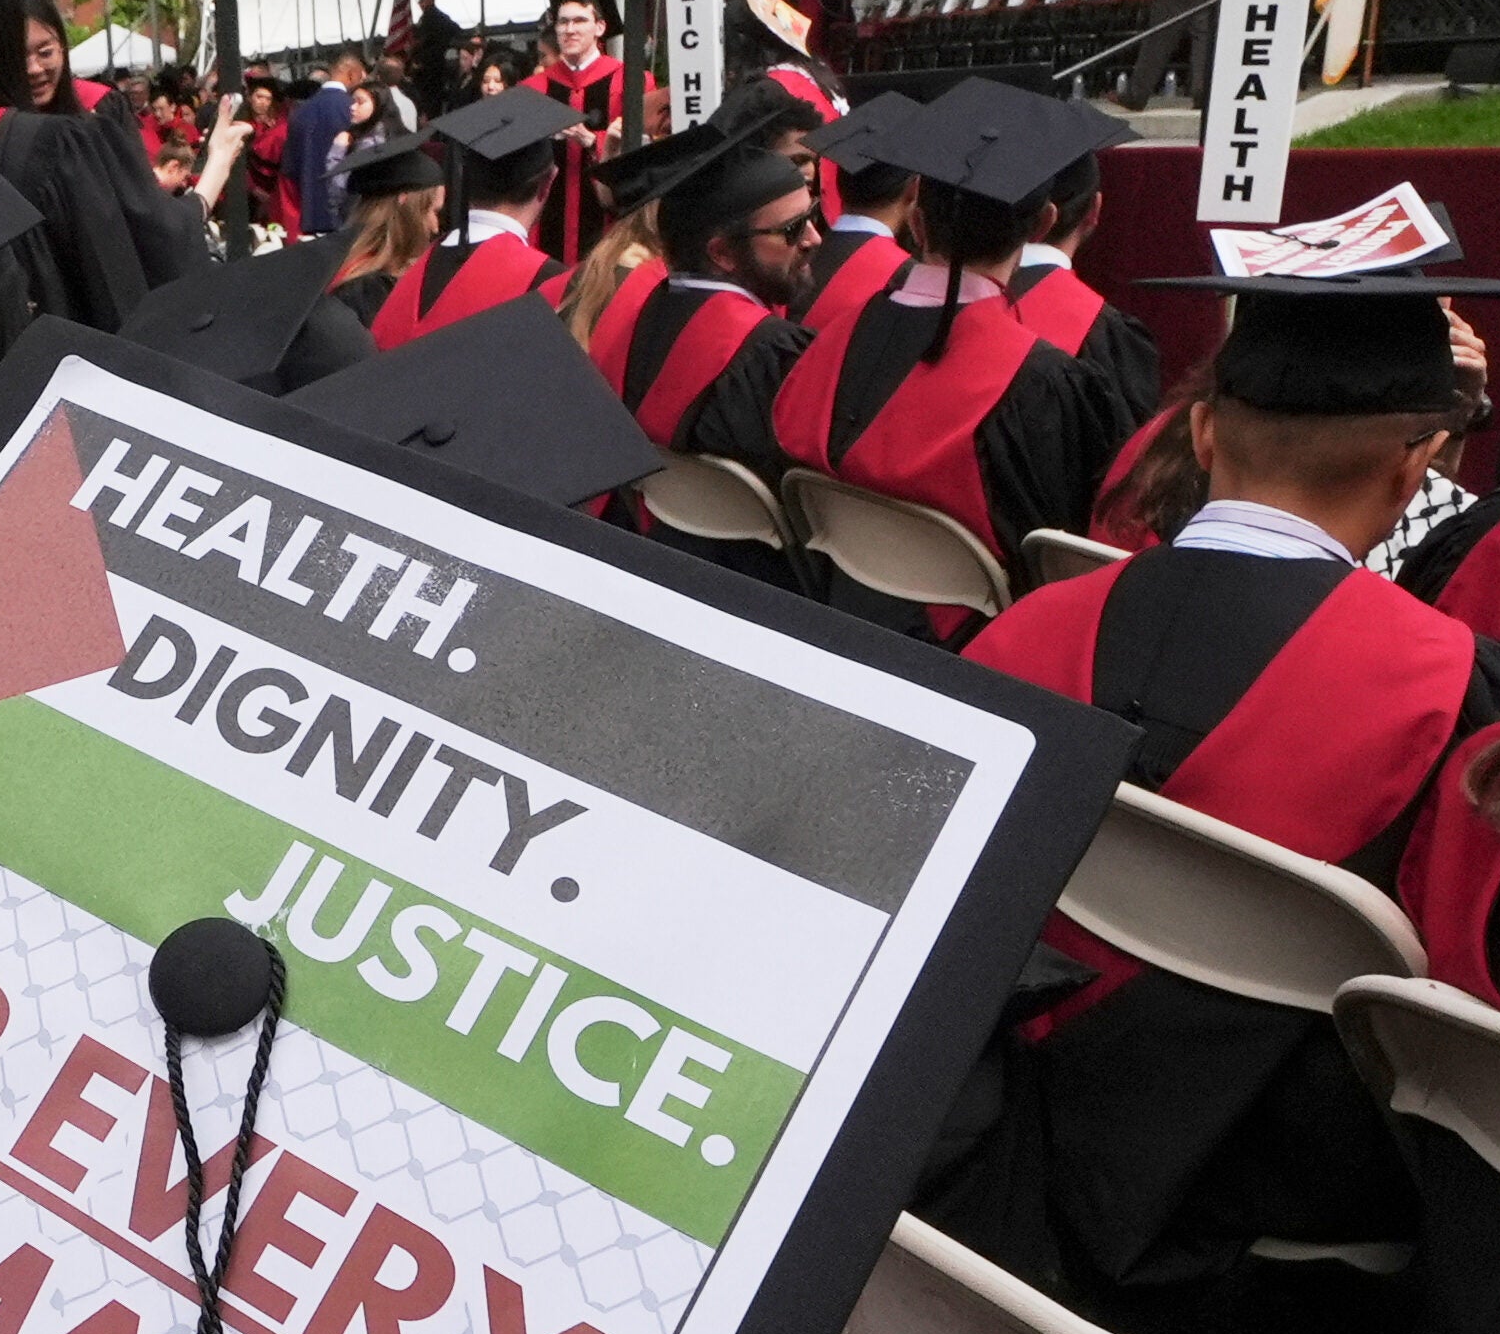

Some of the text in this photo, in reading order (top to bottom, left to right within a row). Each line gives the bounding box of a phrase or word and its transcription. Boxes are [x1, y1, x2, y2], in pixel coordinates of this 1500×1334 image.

[1221, 3, 1278, 203] HEALTH
[68, 436, 480, 675] HEALTH.
[103, 611, 591, 905] DIGNITY.
[223, 837, 738, 1169] JUSTICE.
